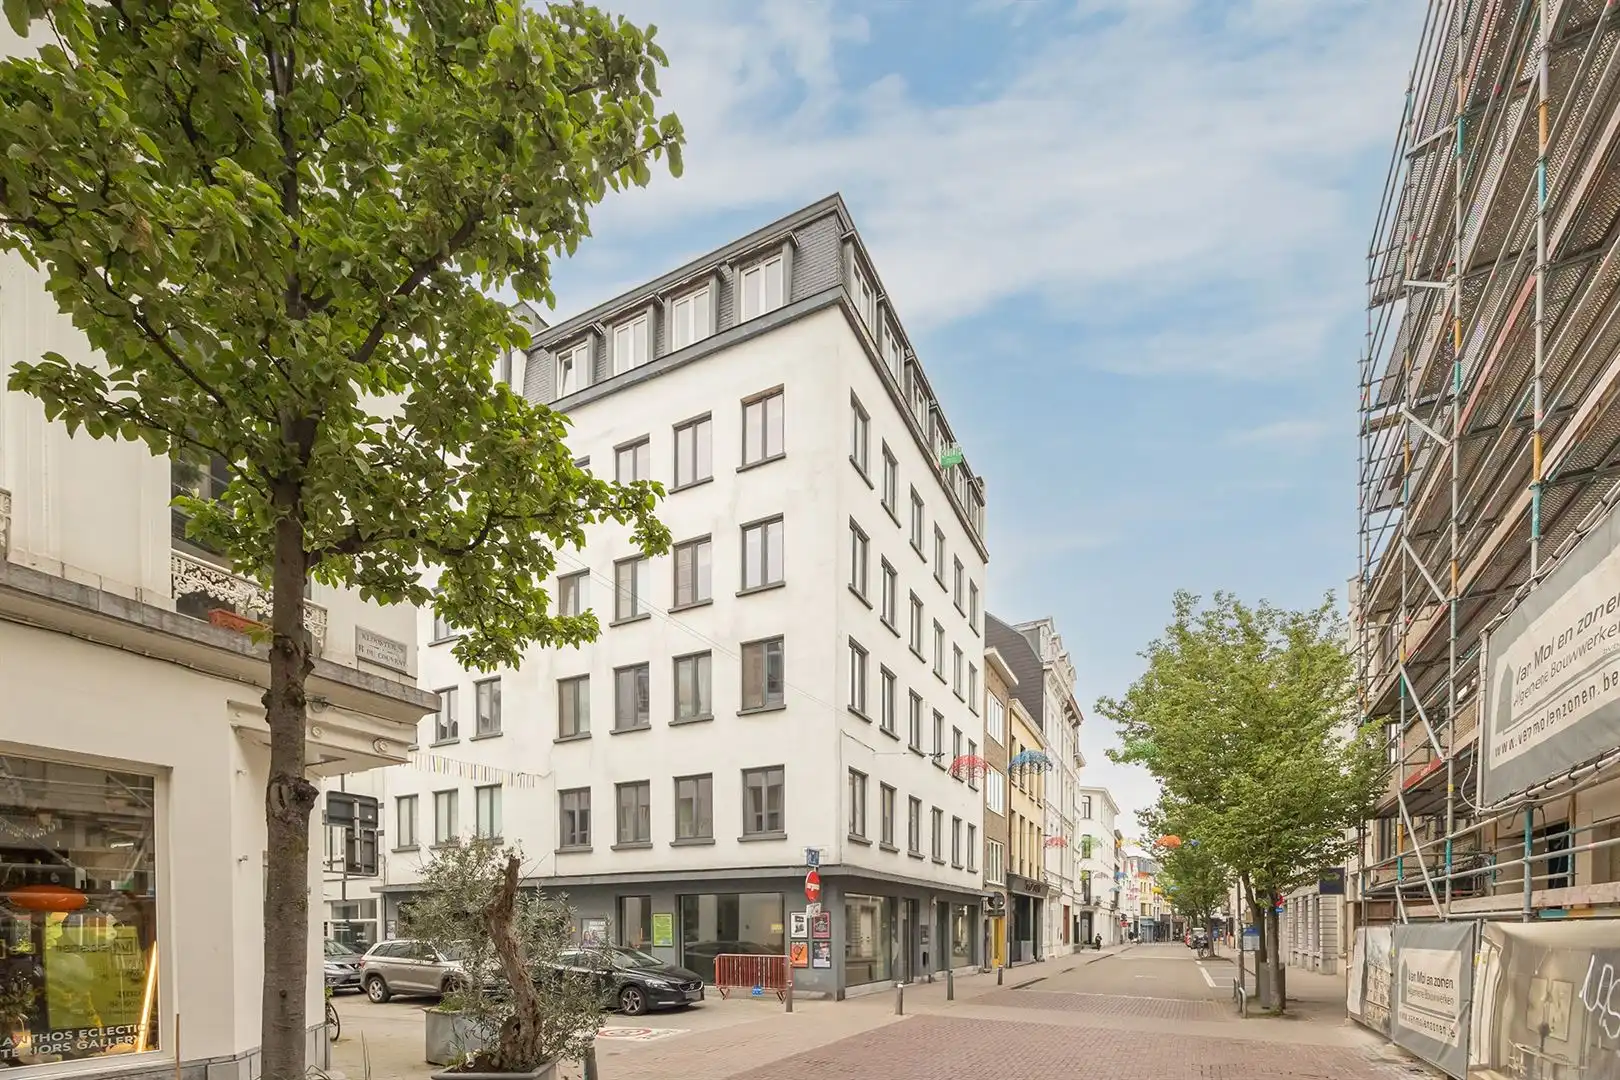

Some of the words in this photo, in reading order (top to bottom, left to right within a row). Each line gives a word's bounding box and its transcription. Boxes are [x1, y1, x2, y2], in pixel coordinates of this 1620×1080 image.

[1534, 637, 1554, 668] Mol
[1557, 627, 1573, 650] en
[1417, 970, 1426, 985] Mol
[1426, 976, 1433, 986] en
[1433, 977, 1454, 990] zonen
